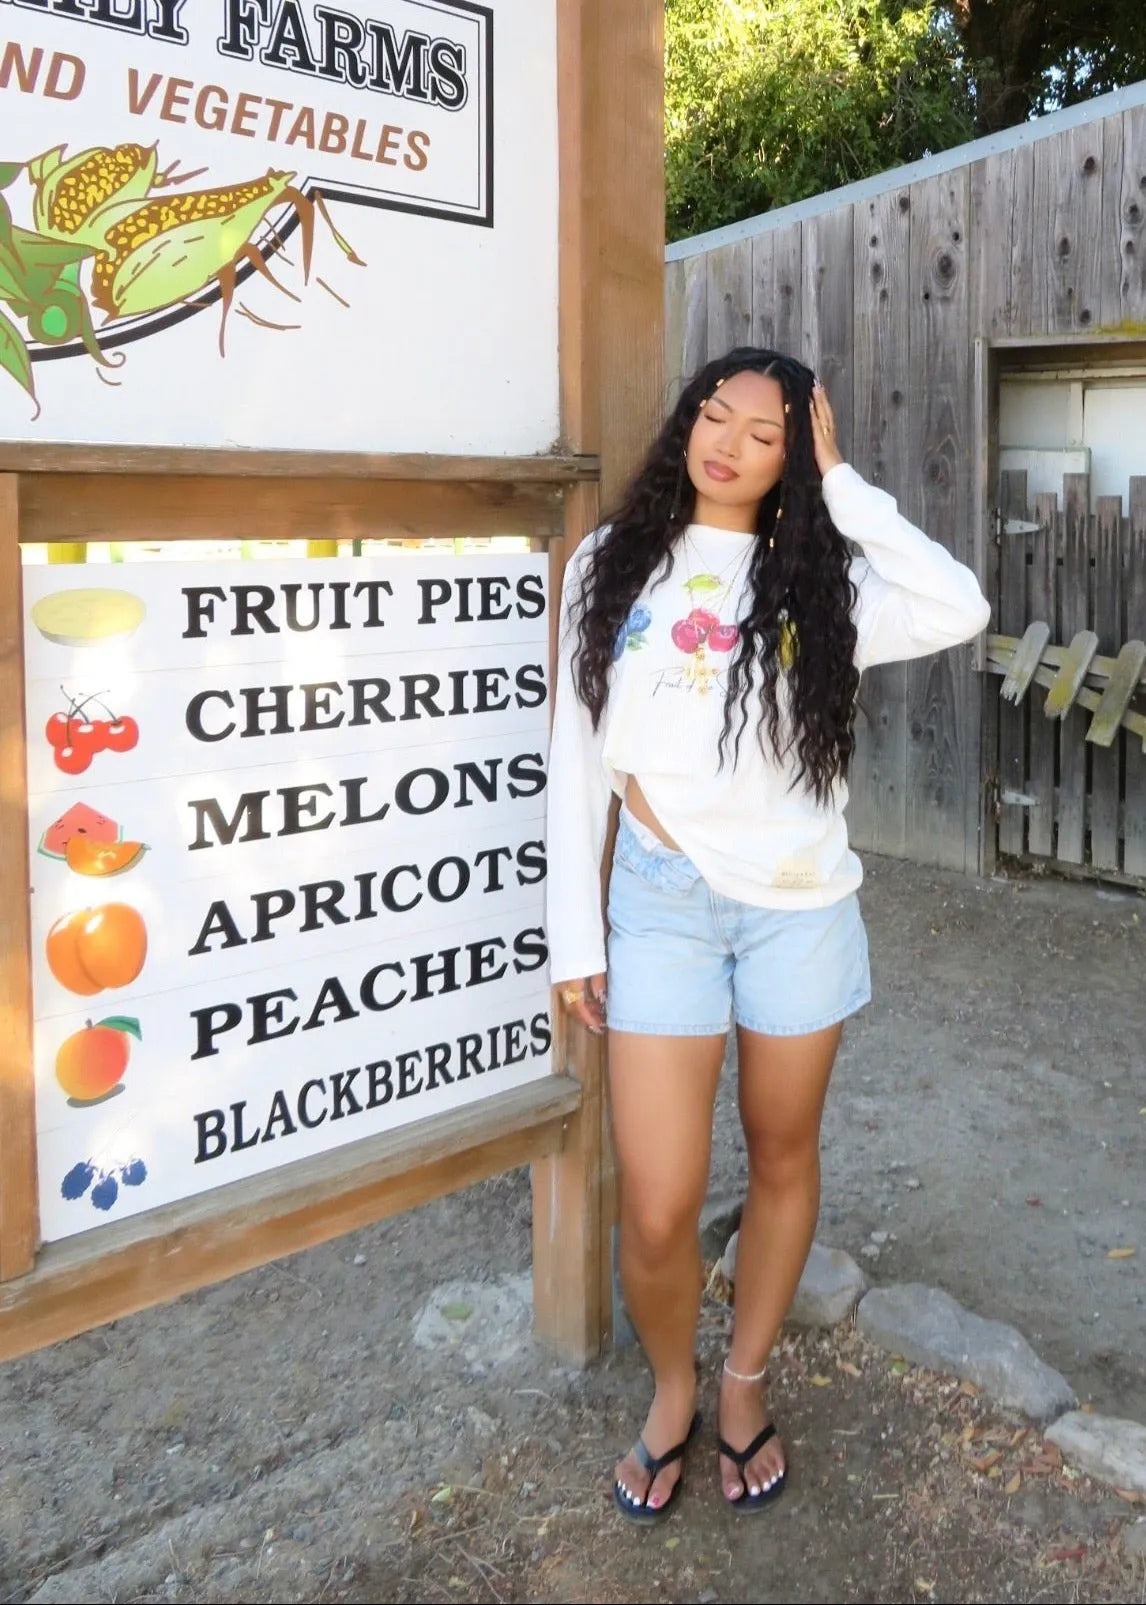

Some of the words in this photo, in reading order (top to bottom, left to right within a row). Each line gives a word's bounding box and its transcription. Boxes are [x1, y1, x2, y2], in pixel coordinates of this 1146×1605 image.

[216, 0, 468, 111] FARMS
[127, 68, 431, 172] VEGETABLES
[181, 580, 394, 639] FRUIT
[417, 574, 546, 625] PIES
[185, 664, 548, 743] CHERRIES
[187, 752, 548, 851] MELONS
[187, 839, 548, 956] APRICOTS
[189, 926, 549, 1061] PEACHES
[193, 1011, 552, 1165] BLACKBERRIES
